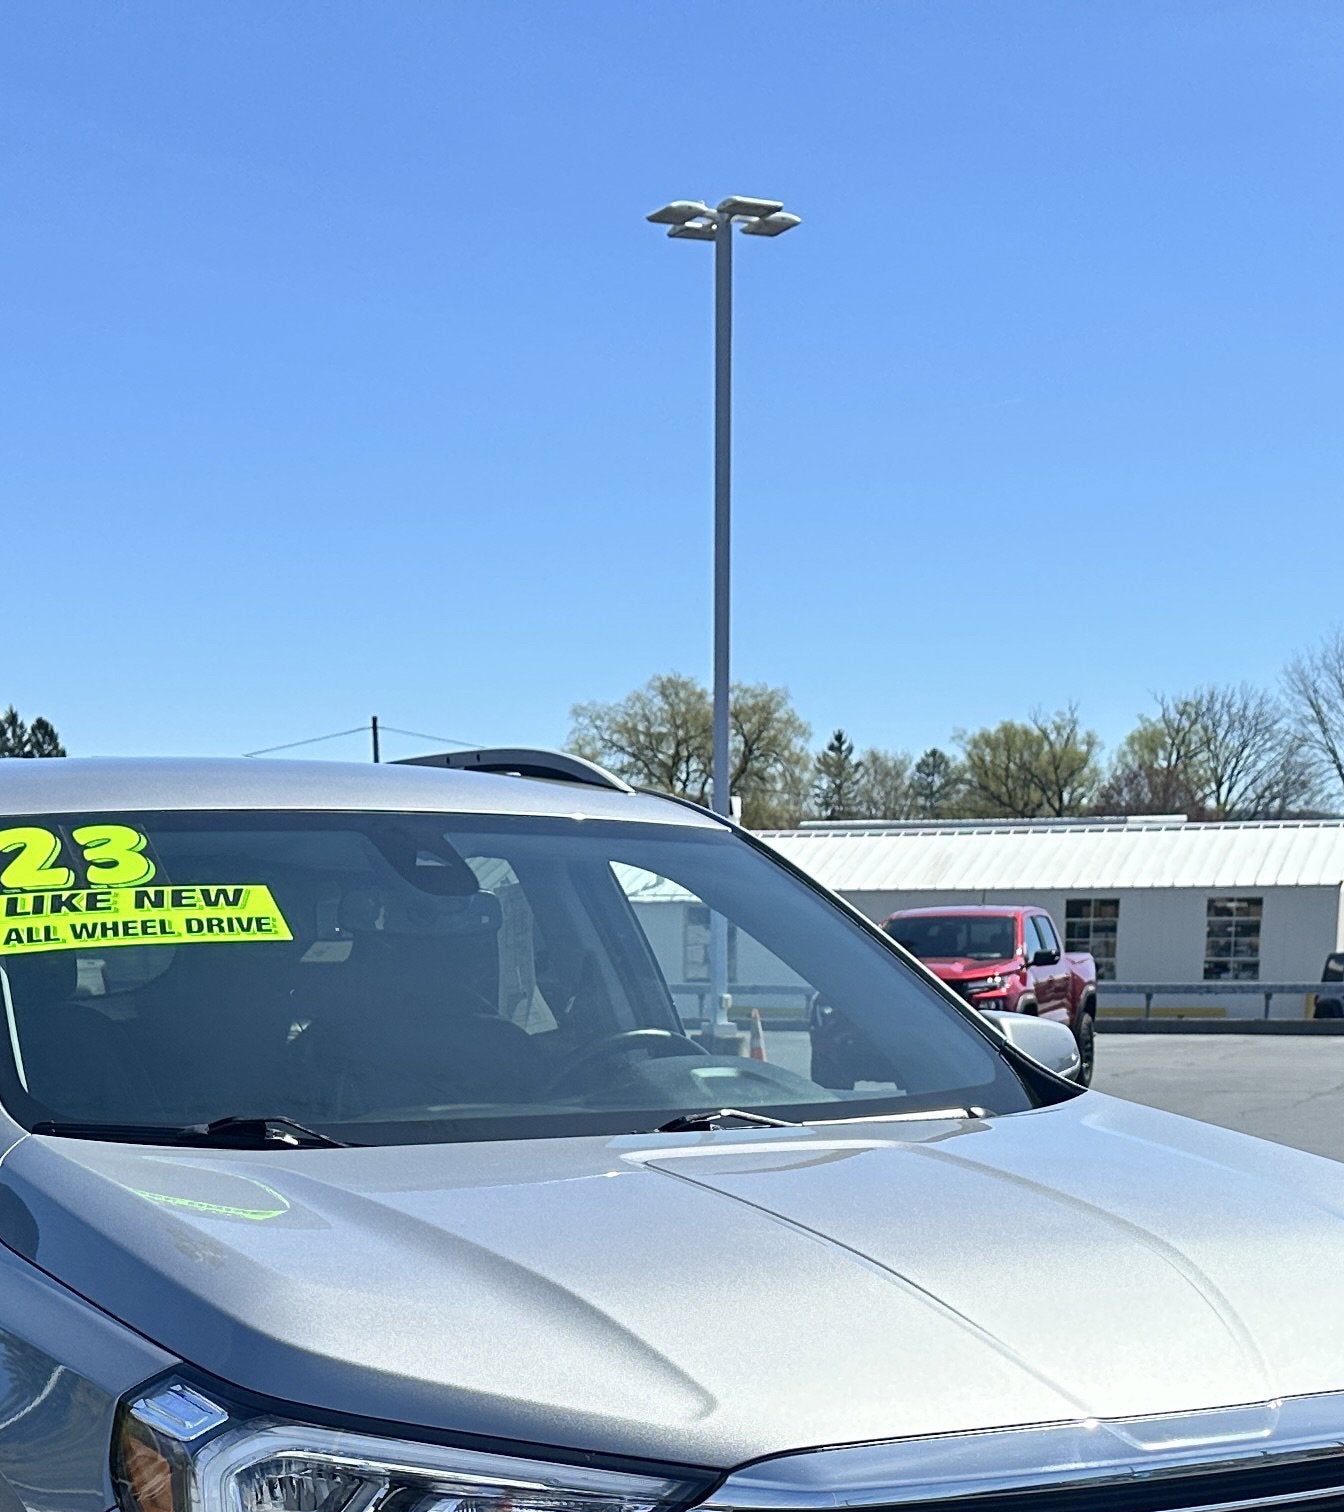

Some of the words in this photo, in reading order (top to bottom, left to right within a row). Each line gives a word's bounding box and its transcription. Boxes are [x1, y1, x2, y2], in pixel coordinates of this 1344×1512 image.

[4, 891, 113, 917] LIKE
[134, 888, 245, 909] NEW
[3, 925, 62, 945] ALL
[69, 919, 177, 940] WHEEL
[185, 916, 274, 935] DRIVE
